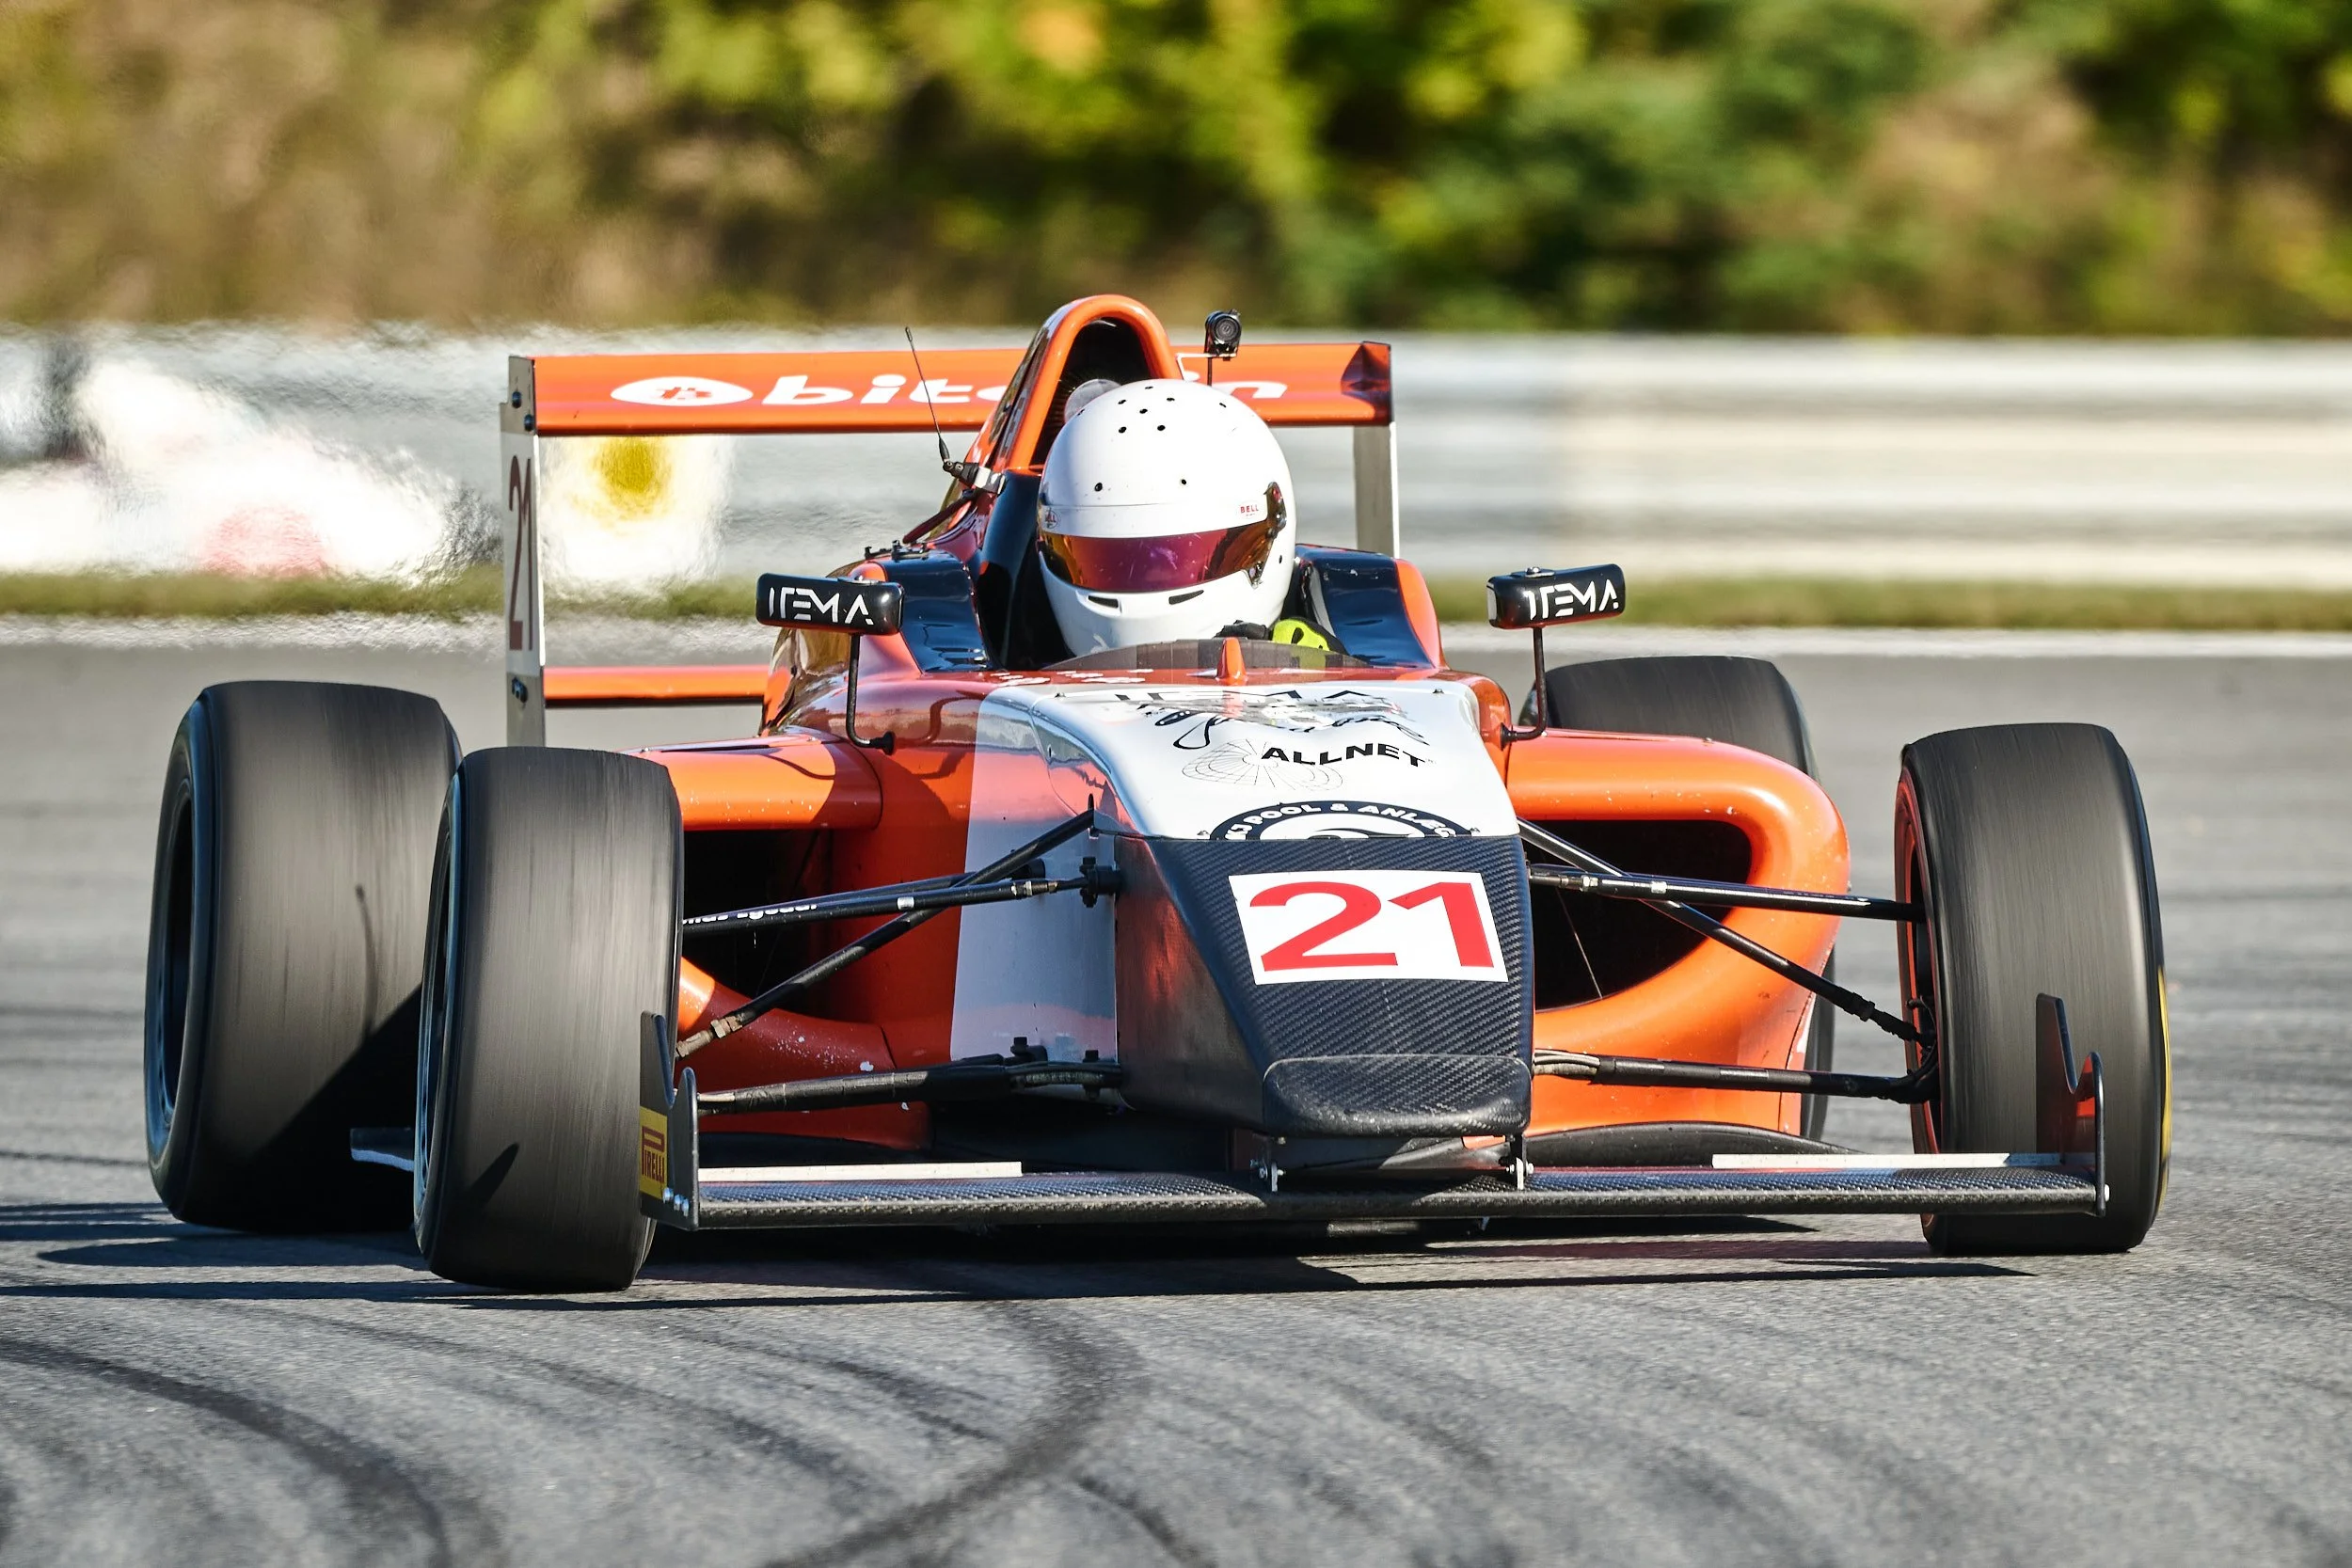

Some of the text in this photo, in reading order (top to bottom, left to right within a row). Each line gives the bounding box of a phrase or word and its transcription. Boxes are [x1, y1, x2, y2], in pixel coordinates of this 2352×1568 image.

[1240, 504, 1260, 513] BELL
[508, 455, 533, 651] 21
[1262, 743, 1425, 768] ALLNET
[1243, 804, 1321, 825] POOL
[1330, 803, 1349, 812] &
[1250, 881, 1494, 971] 21
[642, 1125, 664, 1183] PIRELLI
